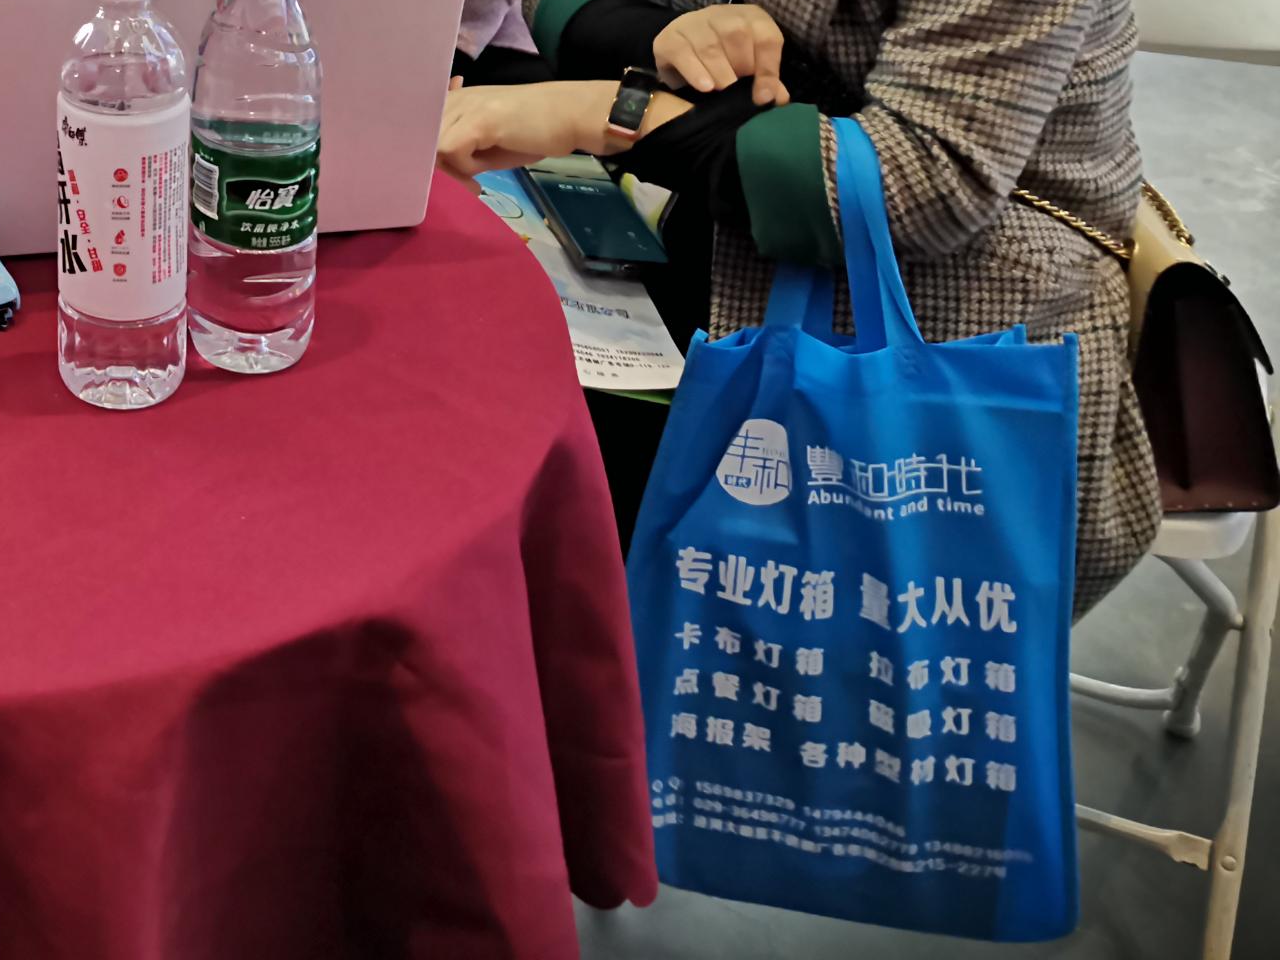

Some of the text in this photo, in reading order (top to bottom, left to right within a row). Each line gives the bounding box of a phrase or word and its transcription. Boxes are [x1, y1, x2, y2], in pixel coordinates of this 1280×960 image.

[900, 496, 928, 517] and
[936, 498, 985, 517] time
[675, 546, 1018, 634] 专业灯箱 量大从优
[674, 621, 825, 676] 卡布灯箱
